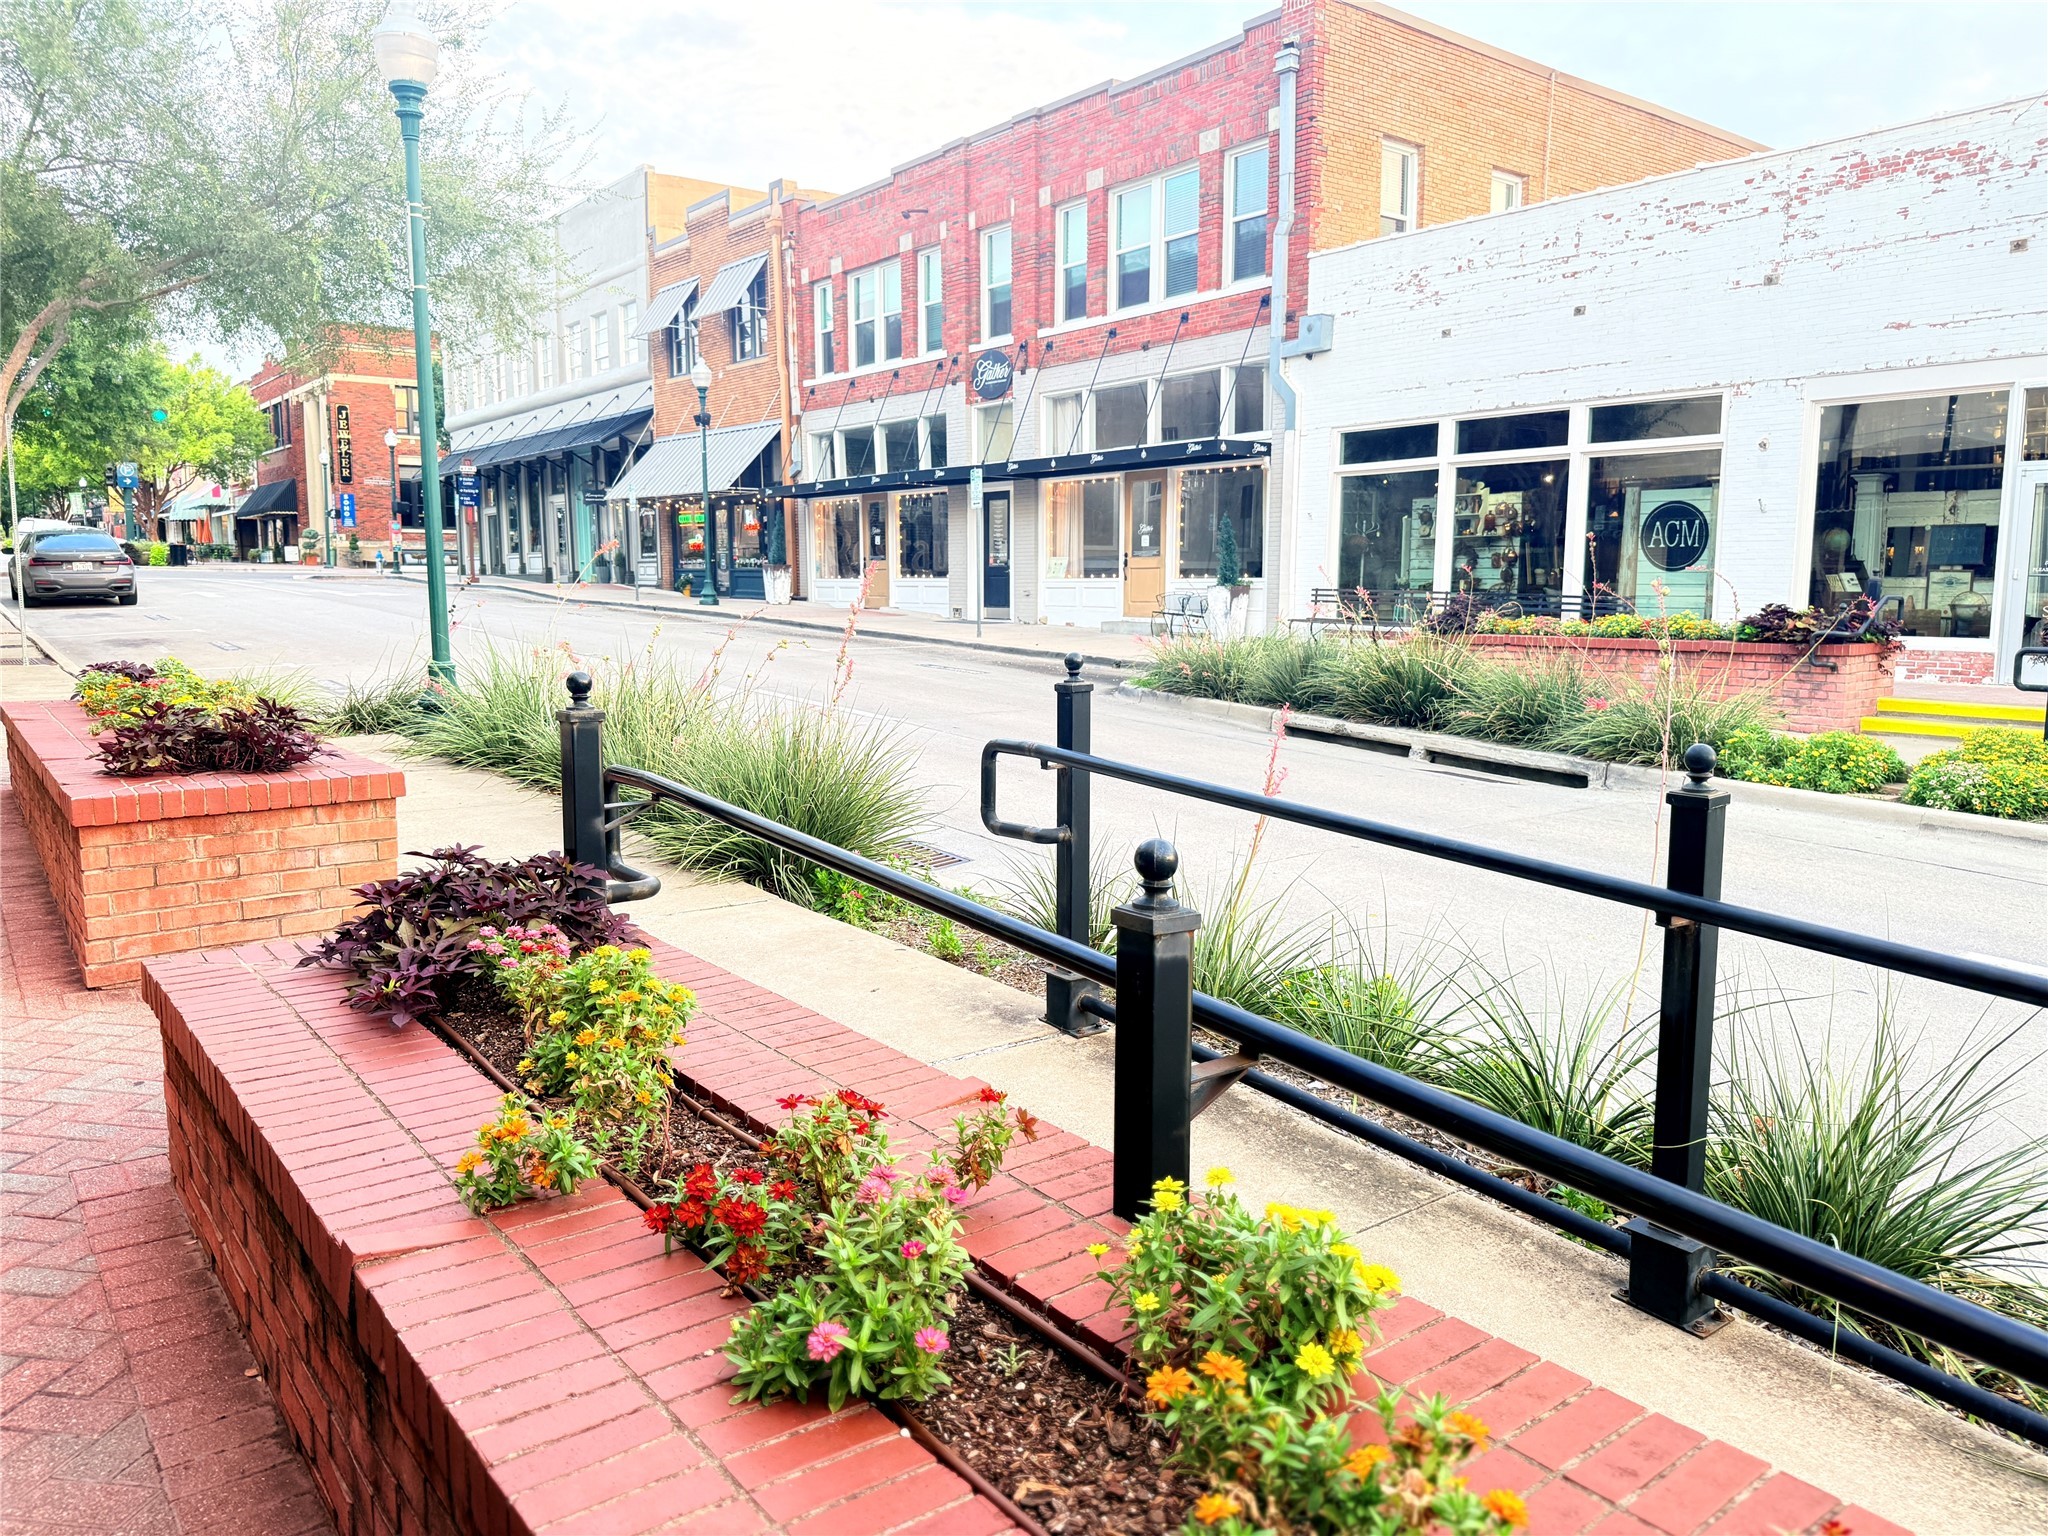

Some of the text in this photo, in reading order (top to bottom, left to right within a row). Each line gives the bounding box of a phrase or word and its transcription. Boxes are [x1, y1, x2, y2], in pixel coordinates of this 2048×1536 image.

[973, 360, 1011, 391] Gather
[338, 410, 351, 477] JEWELER
[1647, 520, 1700, 548] ACM
